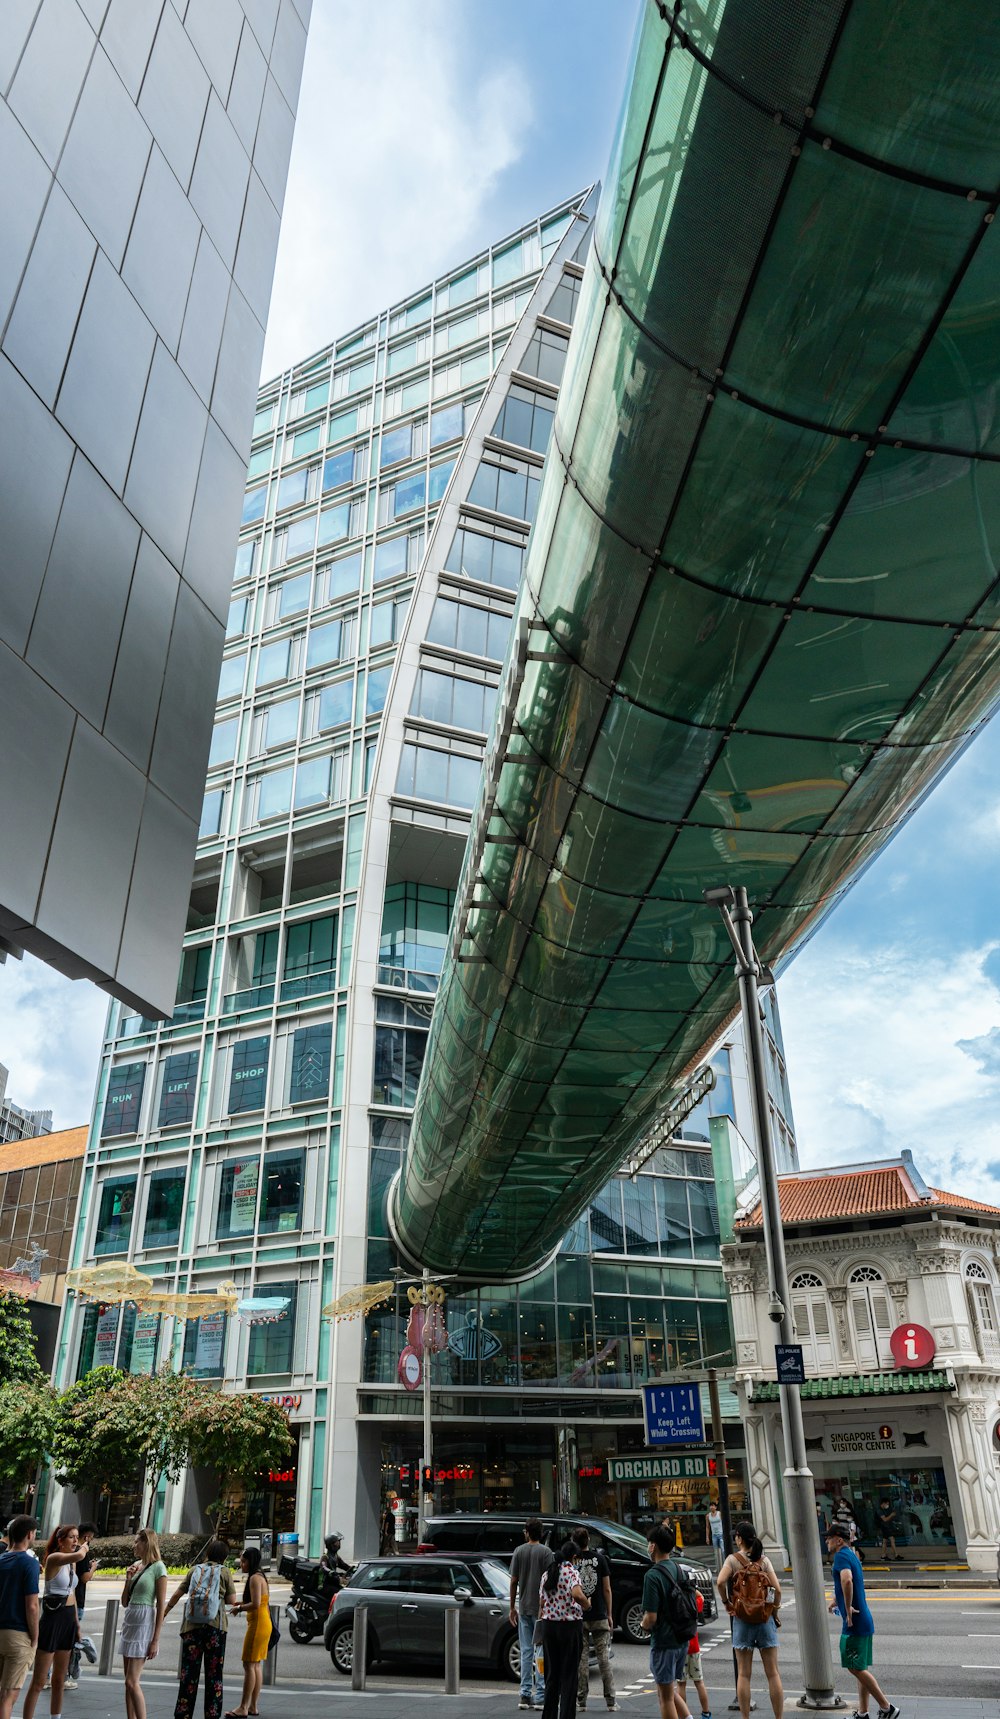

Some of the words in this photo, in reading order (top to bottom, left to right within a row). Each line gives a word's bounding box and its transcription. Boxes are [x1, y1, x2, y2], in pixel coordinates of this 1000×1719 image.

[234, 1067, 265, 1080] SHOP
[168, 1082, 190, 1093] LIFT
[112, 1093, 133, 1104] RUN
[624, 1353, 643, 1362] SOP
[657, 1418, 674, 1428] Keep
[676, 1416, 691, 1426] Left
[650, 1428, 668, 1438] While
[670, 1426, 701, 1437] Crossing
[831, 1432, 876, 1442] SINGAPORE
[832, 1442, 865, 1452] VISITOR
[866, 1441, 896, 1451] CENTRE
[615, 1459, 681, 1479] ORCHARD
[684, 1457, 704, 1476] RD
